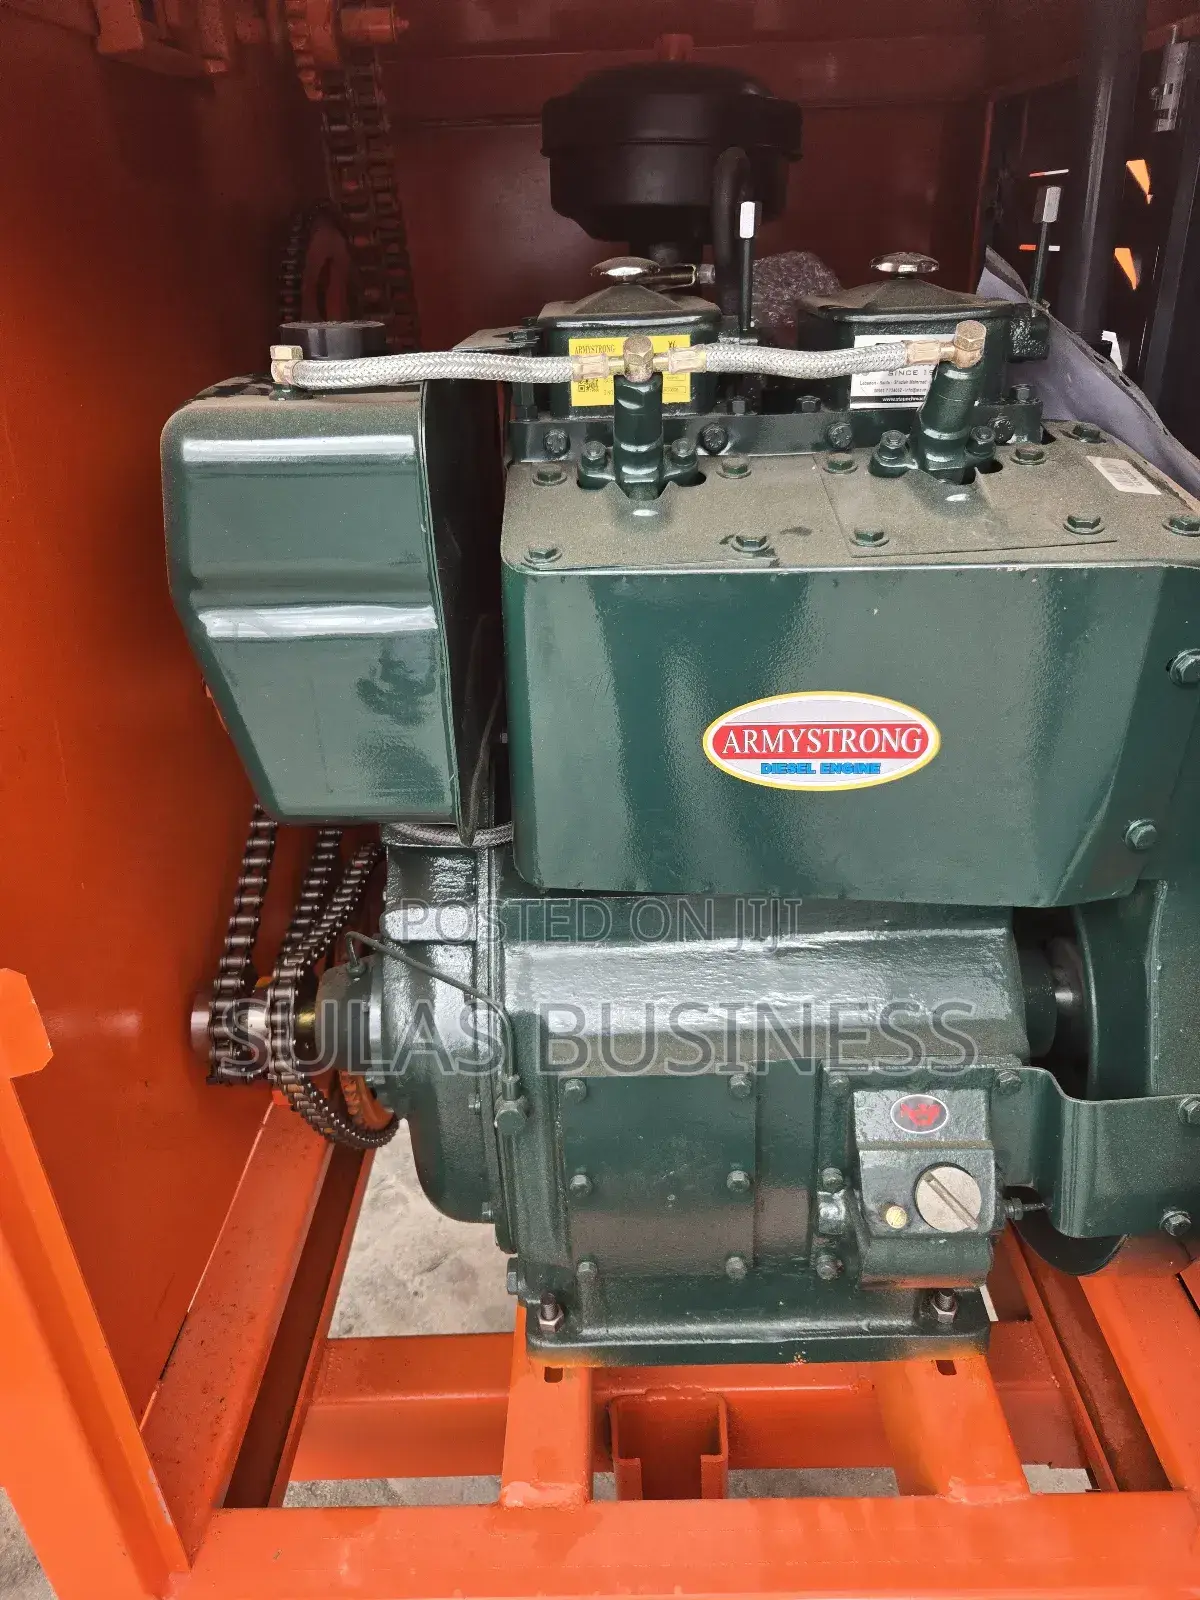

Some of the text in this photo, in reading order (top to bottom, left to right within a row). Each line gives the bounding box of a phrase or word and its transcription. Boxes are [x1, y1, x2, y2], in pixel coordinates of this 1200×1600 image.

[574, 344, 615, 354] ARMYSTRONG
[722, 727, 922, 754] ARMYSTRONG
[761, 762, 881, 774] DIESEL ENGINE
